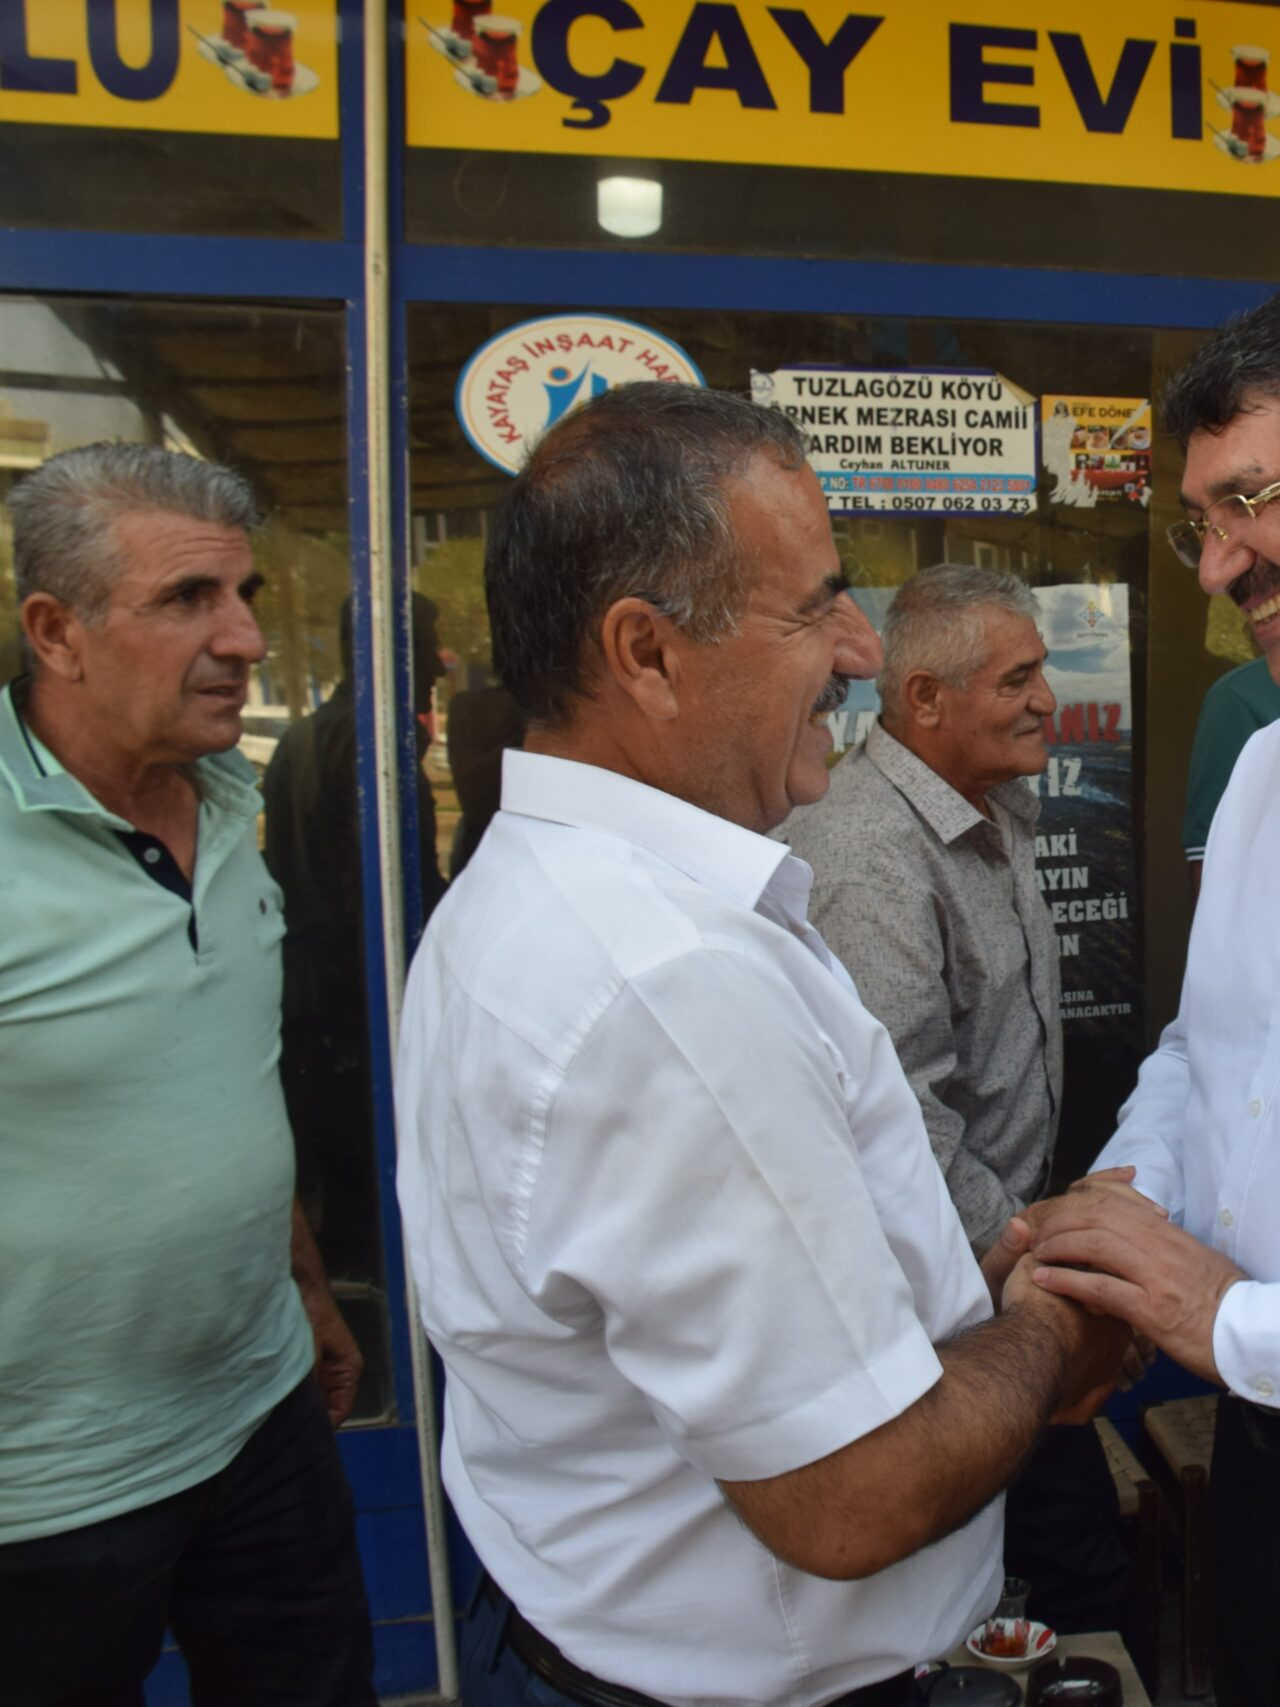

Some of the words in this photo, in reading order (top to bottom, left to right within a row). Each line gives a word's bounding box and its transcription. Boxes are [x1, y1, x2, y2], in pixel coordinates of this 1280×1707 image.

[530, 0, 886, 129] ÇAY
[949, 18, 1203, 141] EVİ
[486, 355, 531, 445] KAYATAŞ
[792, 374, 933, 400] TUZLAGÖZÜ
[941, 377, 1003, 402] KÖYÜ
[769, 400, 849, 427] RNEK
[856, 406, 957, 429] MEZRASI
[964, 404, 1028, 430] CAMİİ
[1098, 404, 1137, 419] DÖNE
[804, 433, 883, 455] ARDIM
[890, 431, 1004, 457] BEKLİYOR
[839, 457, 884, 473] Ceyhan
[890, 458, 951, 472] ALTUNER
[891, 496, 940, 511] 0507
[942, 496, 976, 511] 062
[980, 497, 1003, 512] 03
